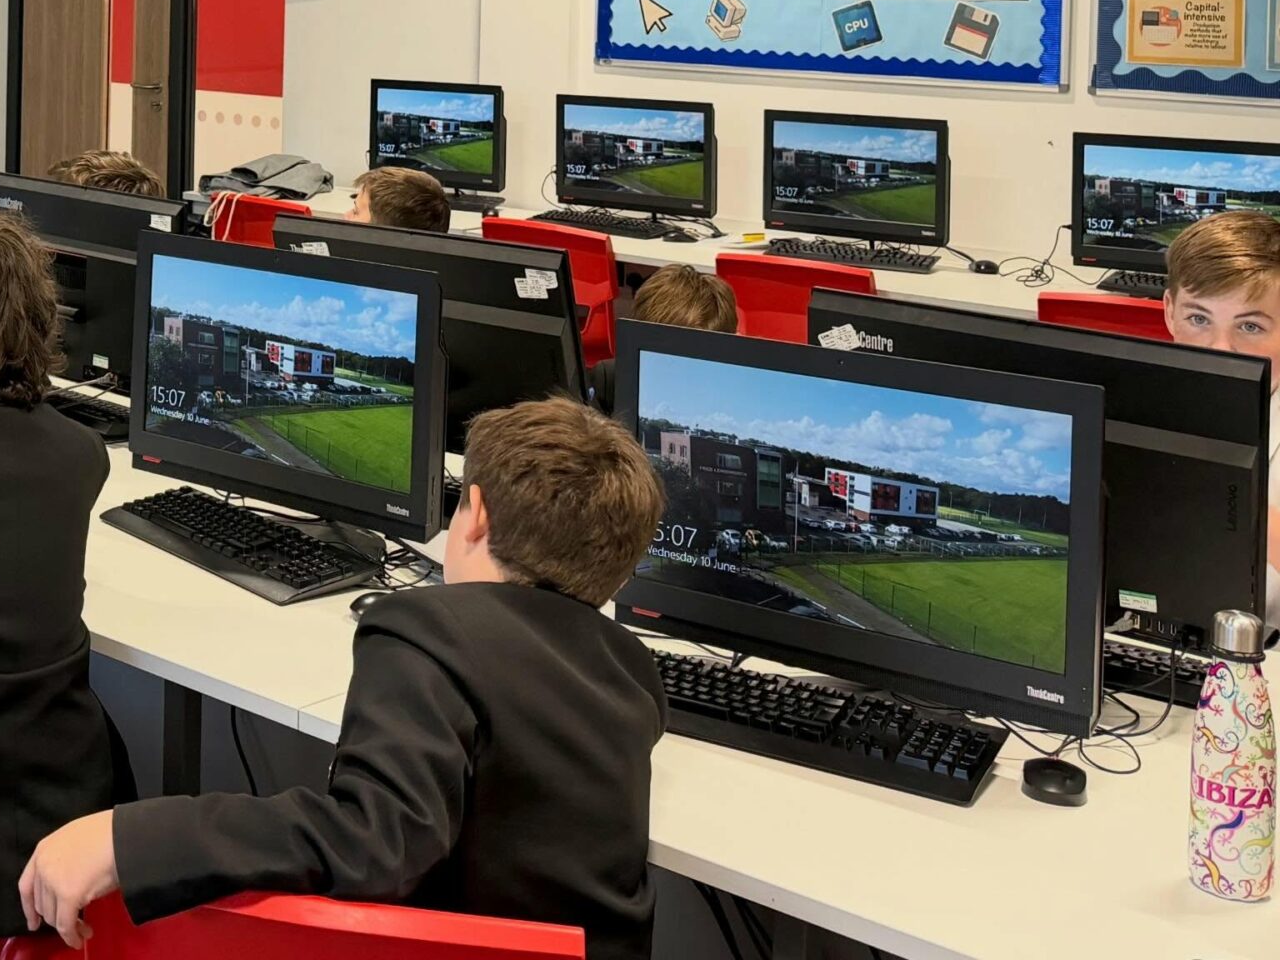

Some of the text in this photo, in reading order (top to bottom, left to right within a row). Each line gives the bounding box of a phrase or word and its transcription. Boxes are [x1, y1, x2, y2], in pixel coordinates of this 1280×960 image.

[1185, 0, 1224, 14] Capital-
[1184, 12, 1226, 22] intensive
[844, 18, 869, 33] CPU
[566, 164, 587, 174] 15:07
[776, 186, 799, 197] 15:07
[1086, 218, 1114, 230] 15:07
[859, 331, 894, 352] Centre
[152, 386, 186, 408] 15:07
[151, 404, 211, 426] Wednesday 10 June
[652, 521, 698, 548] 5:07
[700, 556, 711, 567] 10
[713, 558, 736, 573] June
[1196, 774, 1273, 810] IBIZA
